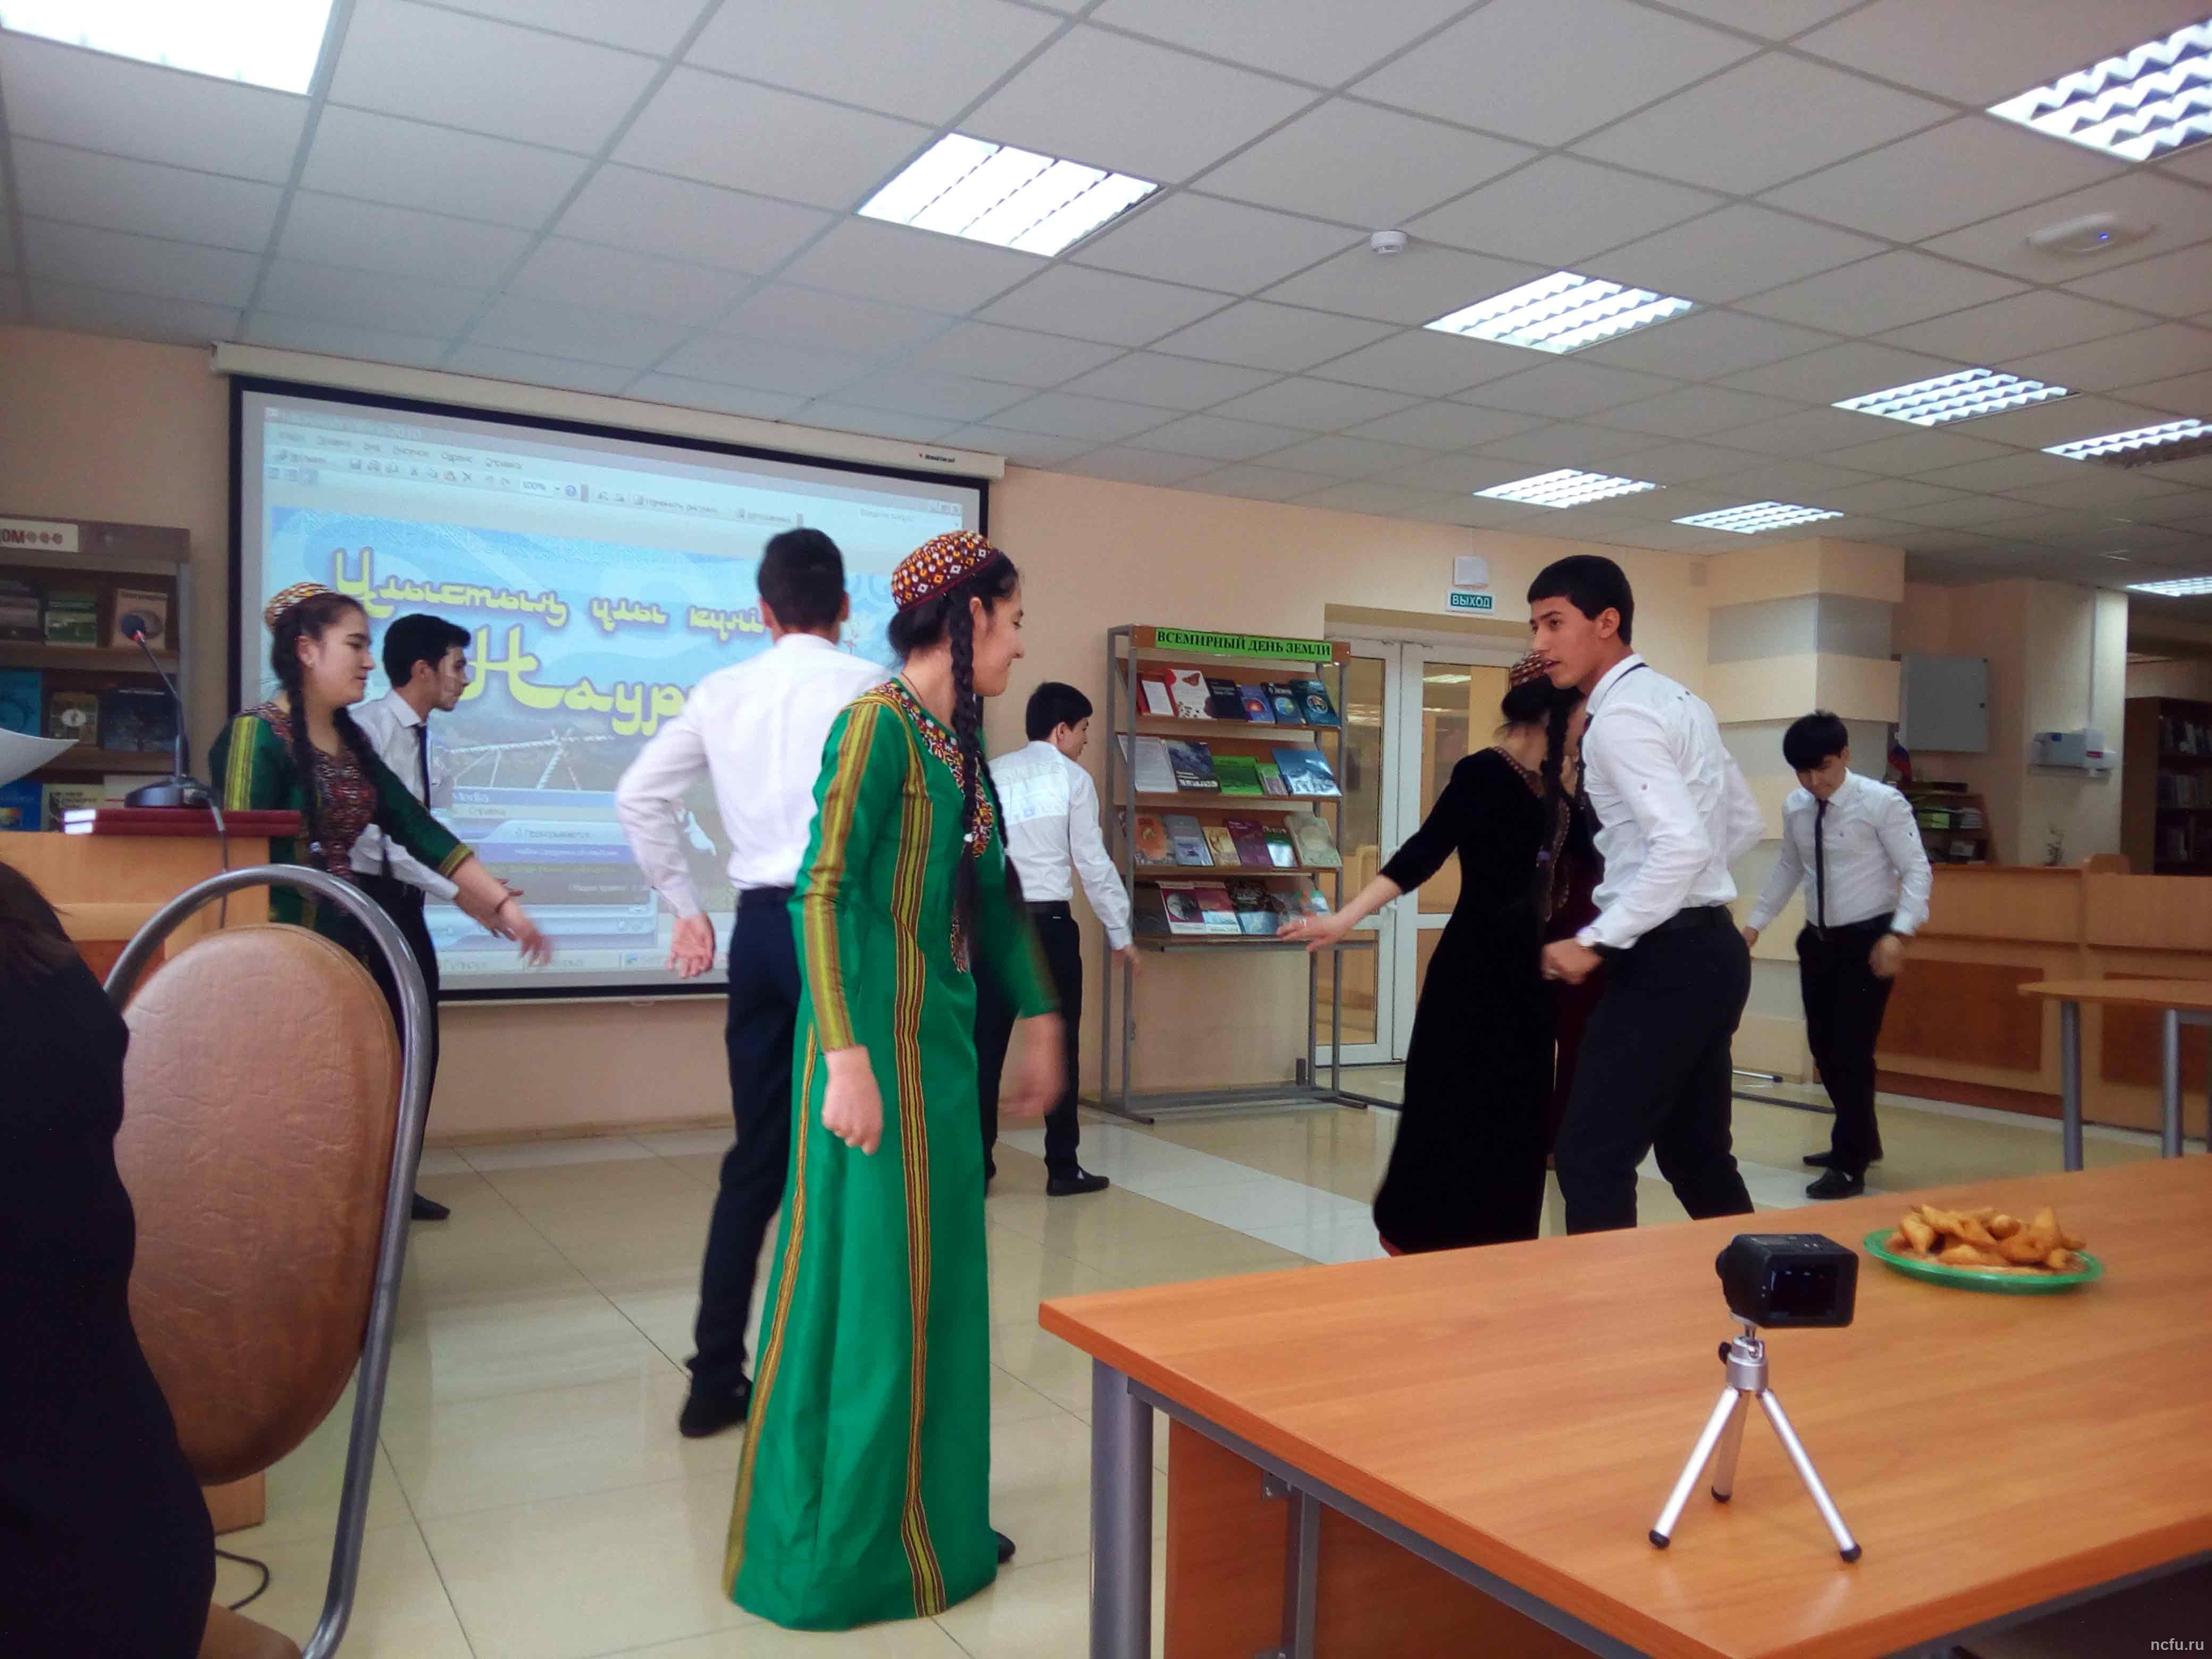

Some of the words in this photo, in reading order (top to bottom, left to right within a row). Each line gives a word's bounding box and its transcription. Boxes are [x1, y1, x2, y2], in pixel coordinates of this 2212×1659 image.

[1452, 594, 1490, 608] ВЫХОД
[1157, 630, 1245, 651] ВСЕМИРНЫЙ
[1248, 640, 1284, 653] ДЕНЬ
[1286, 642, 1330, 656] ЗЕМЛИ
